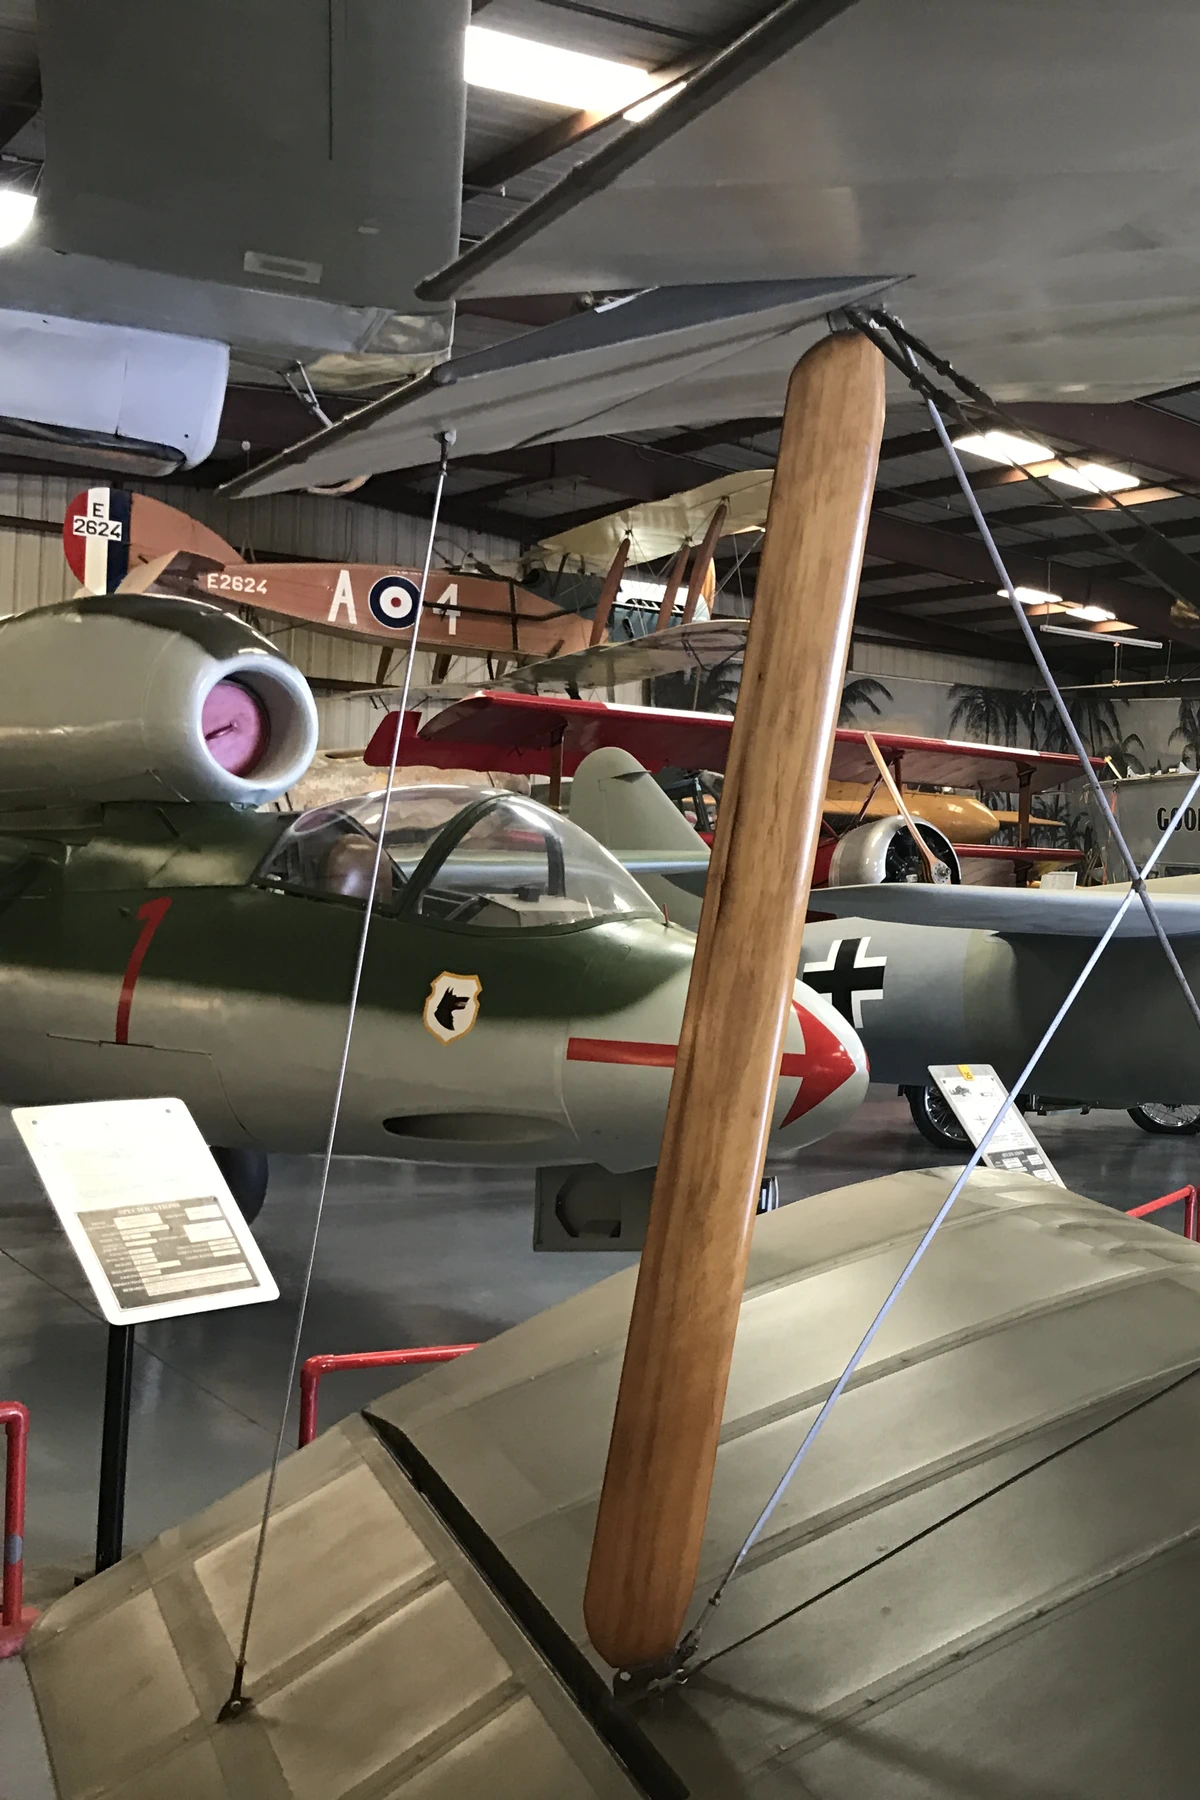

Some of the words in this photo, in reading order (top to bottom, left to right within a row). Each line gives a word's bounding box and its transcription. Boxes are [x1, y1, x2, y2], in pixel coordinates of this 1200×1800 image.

[92, 502, 104, 518] E
[74, 518, 121, 539] 2624
[206, 572, 268, 595] E2624
[327, 569, 357, 625] A
[432, 583, 461, 635] 4
